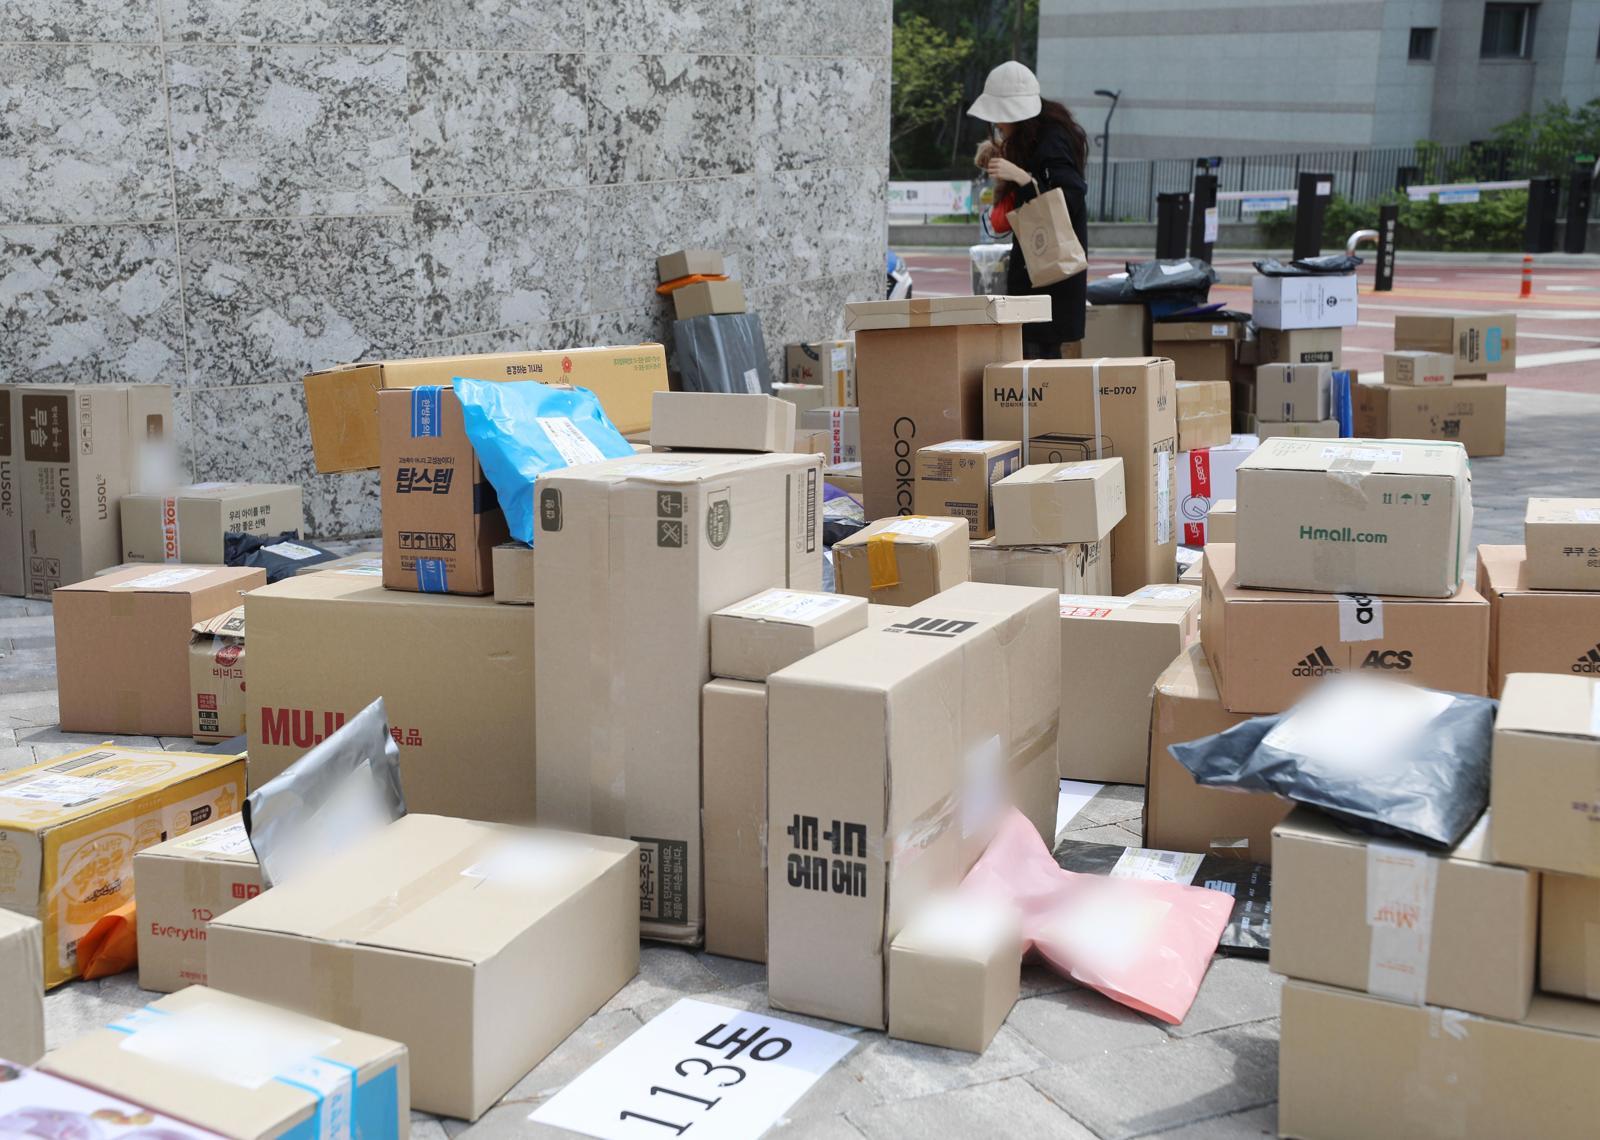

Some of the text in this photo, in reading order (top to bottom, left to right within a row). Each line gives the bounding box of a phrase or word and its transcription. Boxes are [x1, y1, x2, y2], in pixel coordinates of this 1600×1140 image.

[30, 408, 48, 448] 루솔
[0, 461, 12, 510] LUSOL
[396, 467, 454, 494] 탑스텝
[59, 467, 72, 518] LUSOL
[97, 479, 107, 520] LUSOL
[229, 504, 271, 520] 우리 아이를 위한
[230, 522, 241, 533] 가장
[254, 518, 266, 529] 선택
[1300, 524, 1388, 544] Hmall.com
[1562, 547, 1585, 557] 쿠쿠
[1361, 650, 1413, 669] ACS
[213, 667, 243, 679] 비비고
[639, 848, 655, 912] 파손주의
